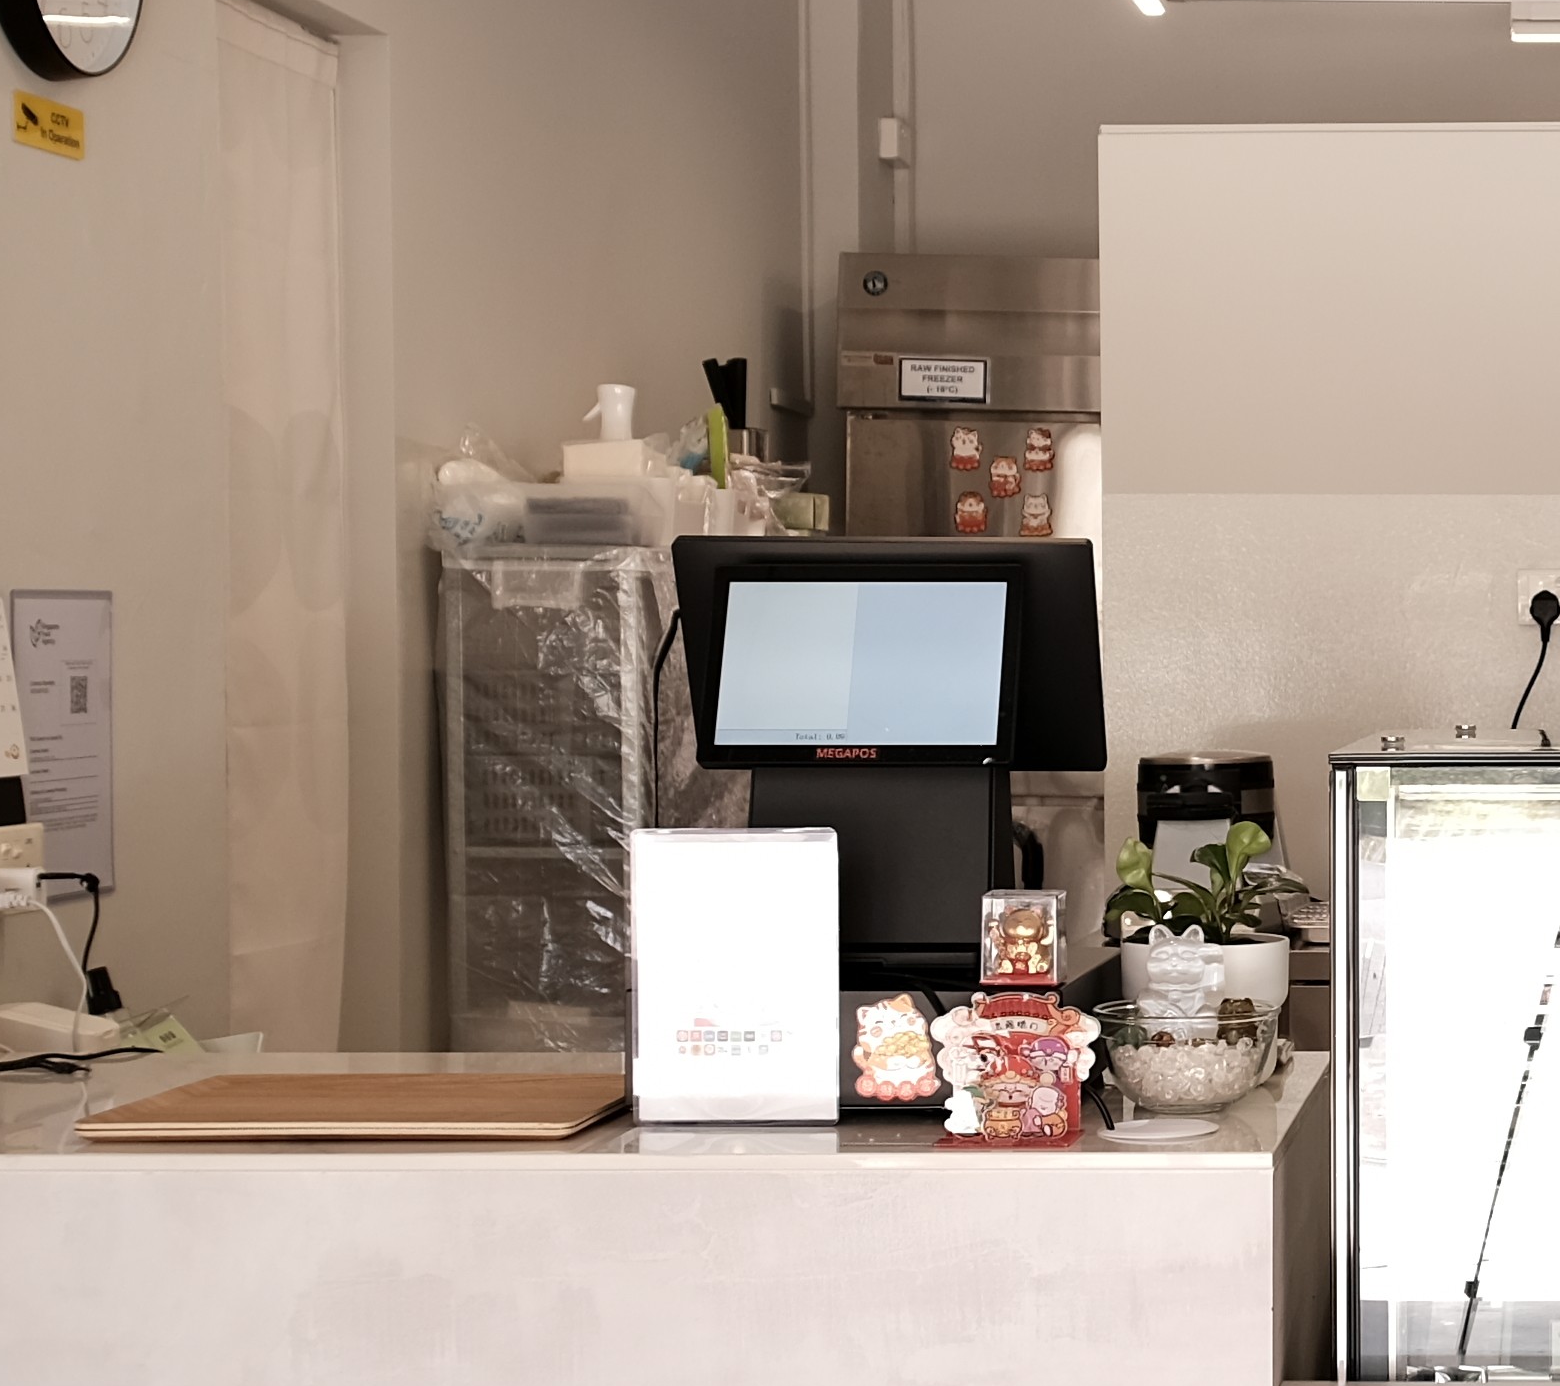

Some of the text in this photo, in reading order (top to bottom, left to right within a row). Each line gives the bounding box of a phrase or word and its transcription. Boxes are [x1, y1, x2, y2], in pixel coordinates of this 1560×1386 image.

[50, 112, 69, 128] CCTV
[48, 129, 80, 149] Operation
[910, 363, 975, 373] RAW FINISHED
[922, 375, 963, 383] FREEZER
[795, 733, 822, 741] Total:
[816, 748, 878, 759] MEGAPOS
